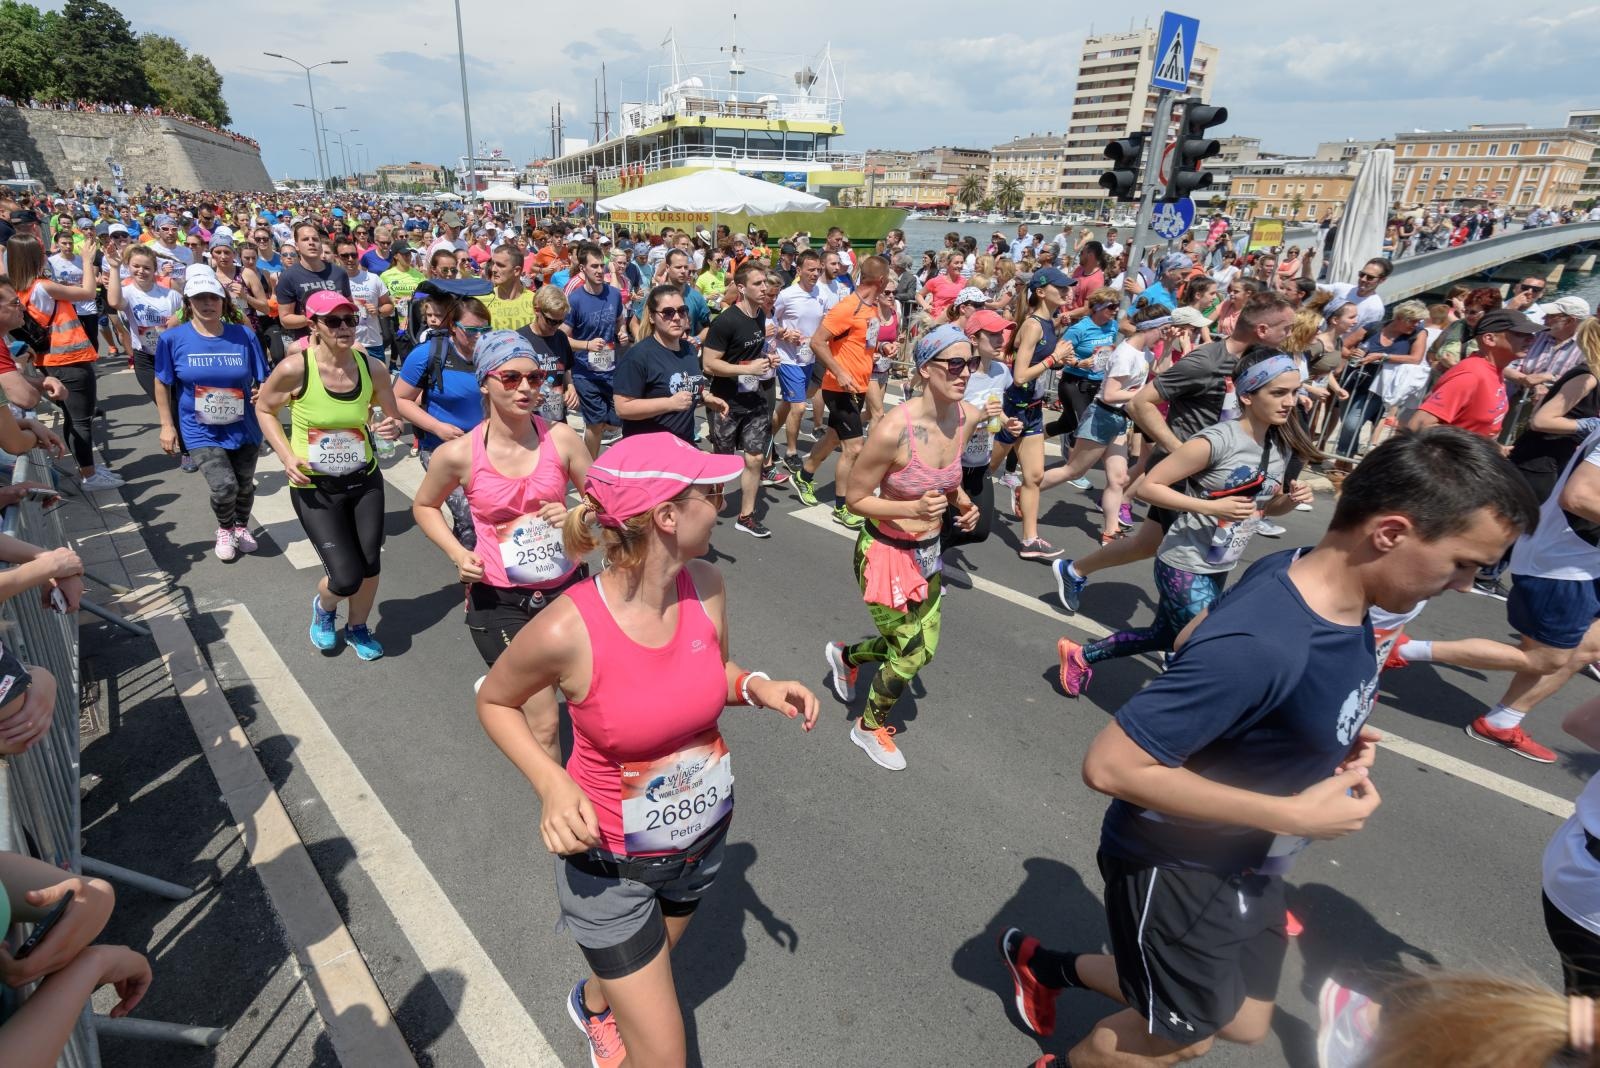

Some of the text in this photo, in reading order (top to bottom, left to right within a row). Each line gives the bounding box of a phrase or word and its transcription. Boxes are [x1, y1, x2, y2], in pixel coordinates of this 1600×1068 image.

[636, 212, 709, 222] EXCURSIONS
[300, 280, 336, 292] THIS
[188, 356, 243, 367] PHILIP'S FUND
[203, 404, 237, 415] 50173
[320, 452, 359, 464] 25596
[516, 541, 563, 566] 25354
[535, 562, 555, 574] Maja
[658, 788, 680, 800] WORLD
[645, 786, 718, 831] 26863
[670, 822, 702, 840] Petra
